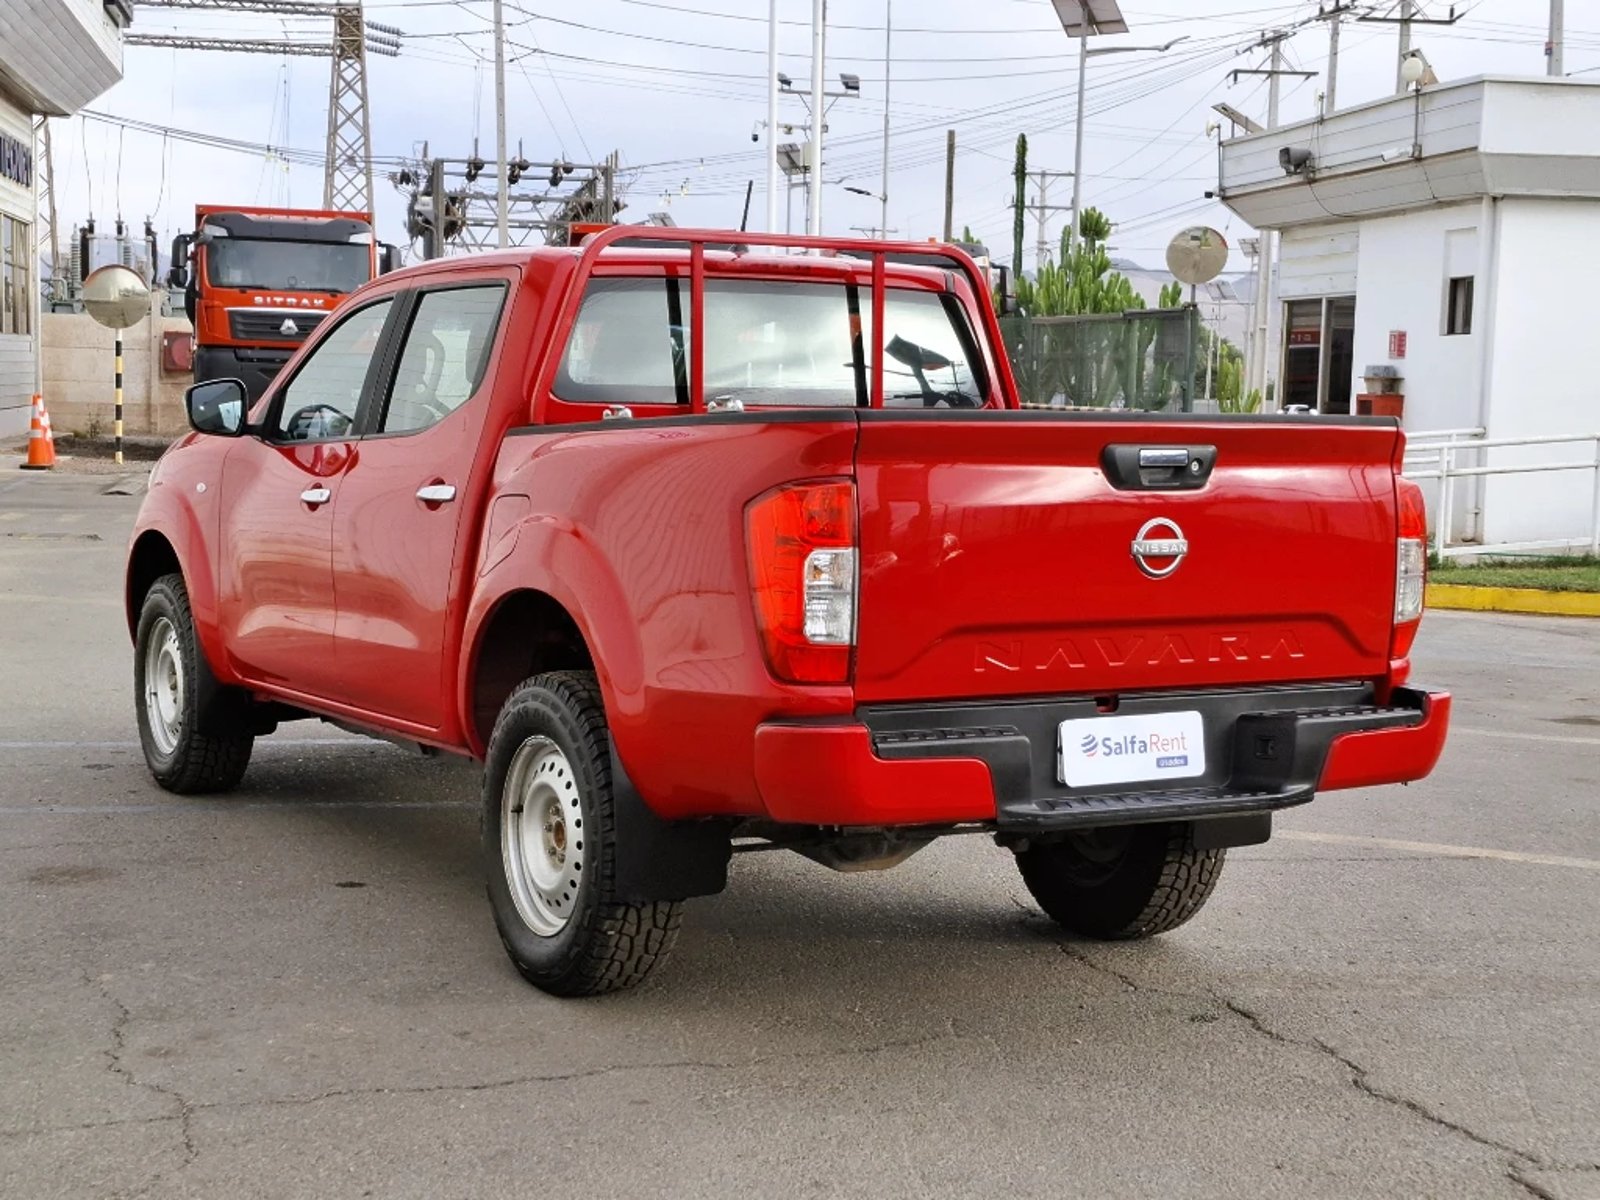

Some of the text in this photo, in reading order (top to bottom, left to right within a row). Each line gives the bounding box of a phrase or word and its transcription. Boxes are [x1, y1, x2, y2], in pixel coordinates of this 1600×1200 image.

[254, 296, 325, 307] SITRAK
[1133, 543, 1187, 553] NISSAN
[974, 629, 1305, 673] NAVARA
[1102, 731, 1188, 757] SalfaRent
